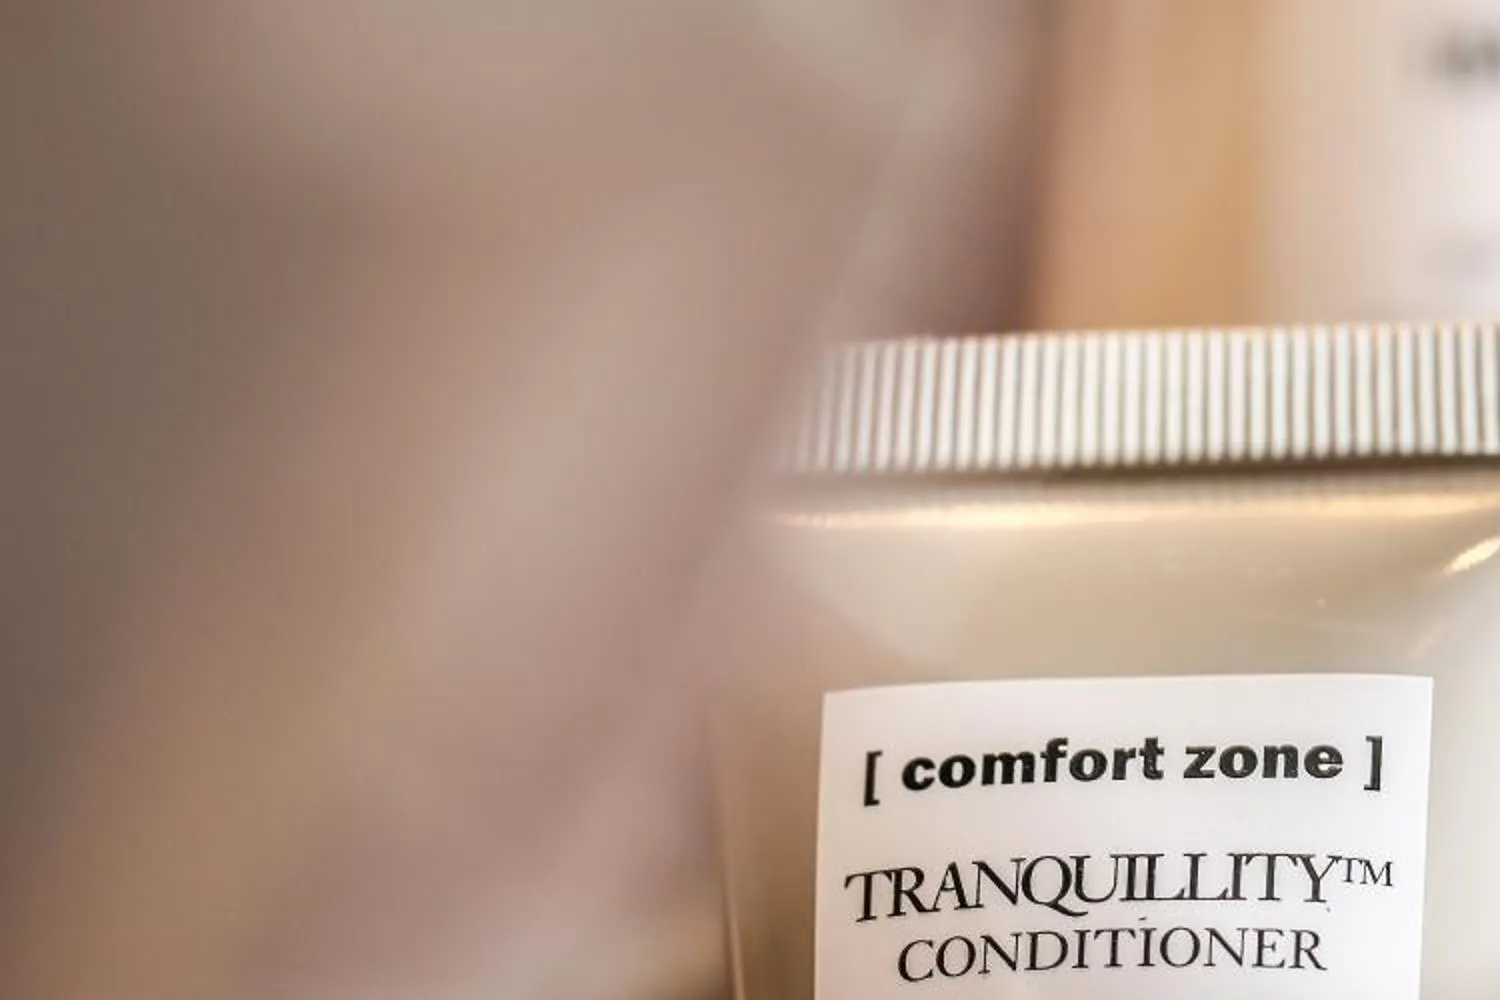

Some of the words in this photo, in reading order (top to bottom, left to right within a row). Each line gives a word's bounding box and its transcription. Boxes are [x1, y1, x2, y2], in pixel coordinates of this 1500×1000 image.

[901, 737, 1163, 791] comfort
[1183, 744, 1344, 780] zone
[898, 925, 1328, 983] CONDITIONER
